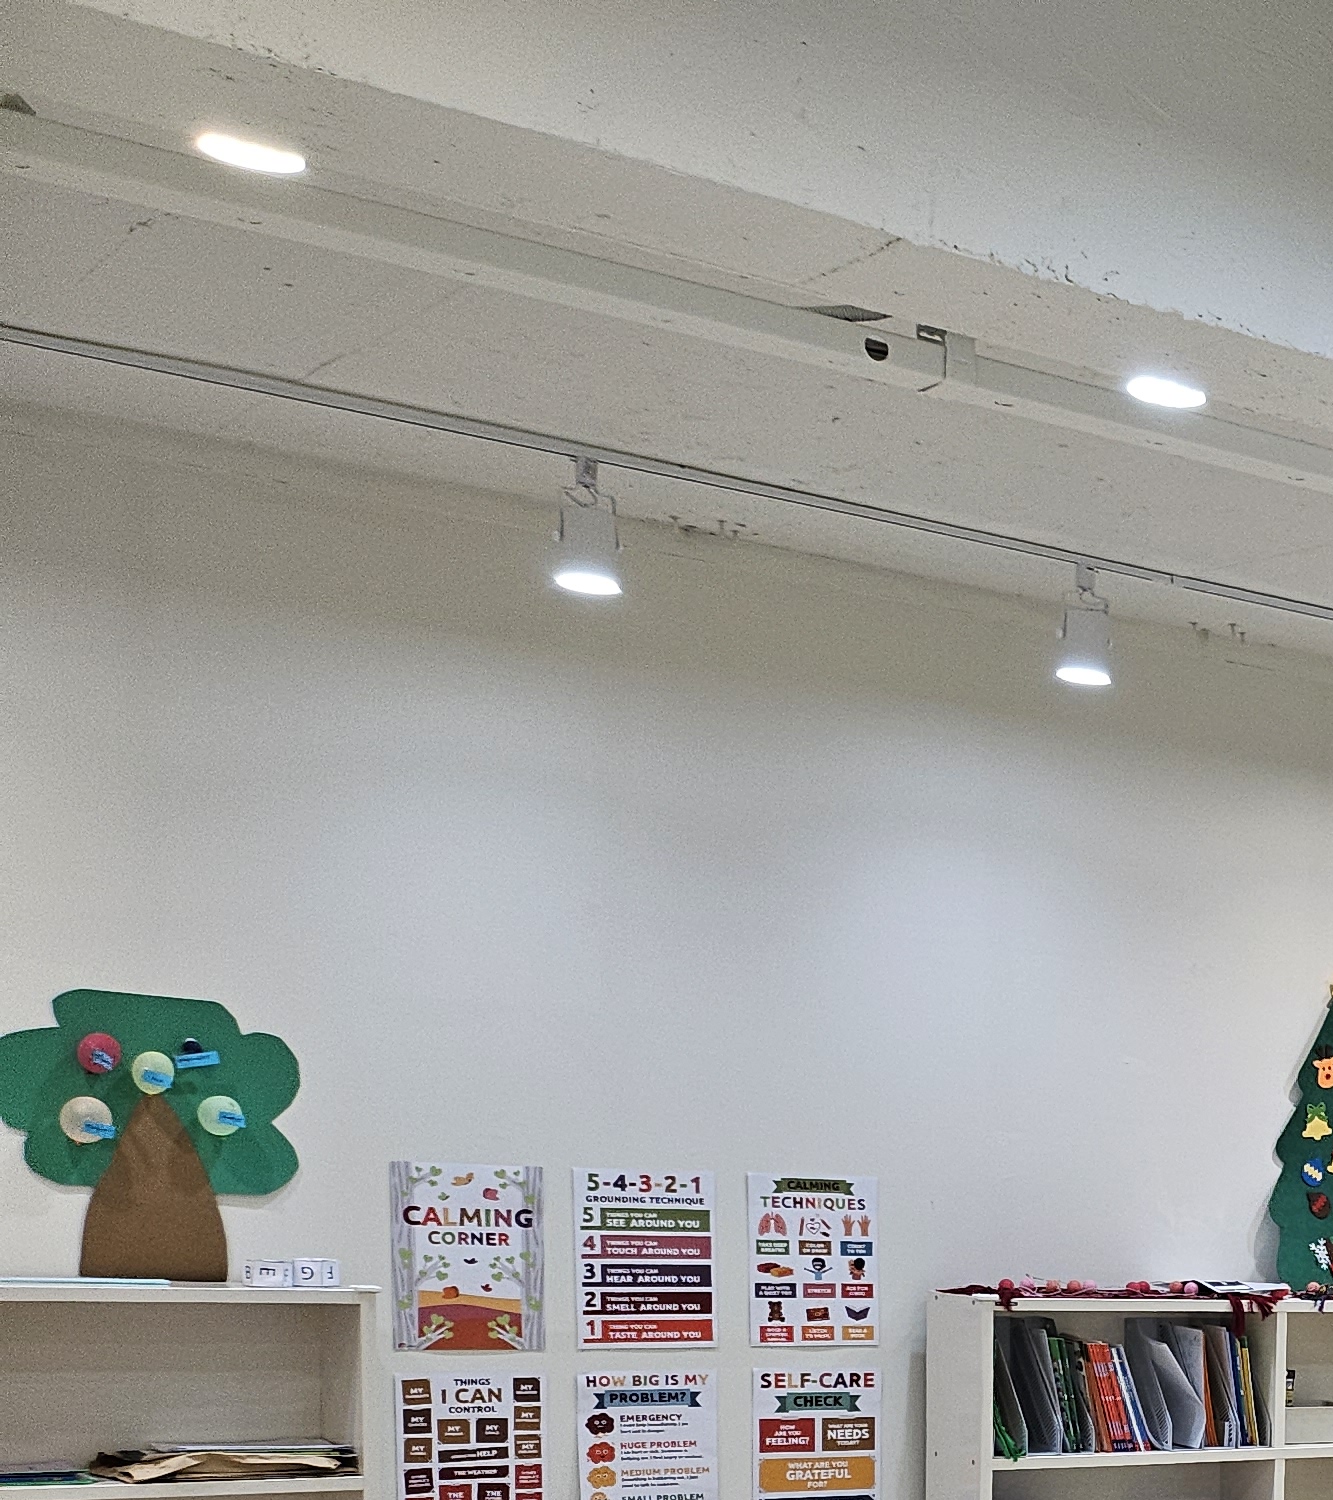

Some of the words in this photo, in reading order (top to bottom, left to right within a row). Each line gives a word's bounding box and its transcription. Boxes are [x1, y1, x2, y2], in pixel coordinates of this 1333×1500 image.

[587, 1173, 701, 1194] 5-4-3-2-1
[787, 1180, 840, 1191] CALMING
[585, 1195, 647, 1204] GROUNDING
[649, 1196, 705, 1206] TECHNIQUE
[760, 1196, 866, 1212] TECHNIQUES
[402, 1205, 533, 1229] CALMING
[583, 1206, 594, 1223] 5
[606, 1219, 627, 1228] SEE
[629, 1219, 676, 1228] AROUND
[678, 1220, 700, 1228] YOU
[427, 1230, 510, 1247] CORNER
[583, 1235, 596, 1251] 4
[606, 1247, 638, 1255] TOUCH
[641, 1247, 679, 1255] AROUND
[681, 1248, 700, 1256] YOU
[259, 1267, 276, 1277] E
[301, 1266, 315, 1281] G
[583, 1263, 596, 1280] 3
[606, 1275, 634, 1283] HEAR
[637, 1275, 679, 1283] AROUND
[680, 1275, 701, 1283] YOU
[584, 1291, 597, 1308] 2
[605, 1303, 637, 1311] SMELL
[640, 1303, 679, 1311] AROUND
[681, 1303, 701, 1311] YOU
[586, 1320, 596, 1336] 1
[608, 1331, 638, 1339] TASTE
[641, 1331, 680, 1339] AROUND
[682, 1331, 702, 1339] YOU
[453, 1378, 491, 1386] THINGS
[585, 1375, 626, 1388] HOW
[632, 1375, 660, 1387] BIG
[665, 1374, 679, 1386] IS
[684, 1374, 709, 1386] MY
[760, 1372, 875, 1389] SELF-CARE
[441, 1389, 447, 1404] I
[455, 1388, 503, 1404] CAN
[609, 1392, 687, 1404] PROBLEM?
[793, 1396, 844, 1407] CHECK
[448, 1406, 498, 1414] CONTROL
[620, 1414, 683, 1423] EMERGENCY
[827, 1428, 870, 1440] NEEDS
[620, 1441, 648, 1450] HUGE
[650, 1440, 698, 1449] PROBLEM
[765, 1437, 810, 1446] FEELING?
[788, 1461, 813, 1469] WHAT
[813, 1461, 830, 1469] ARE
[831, 1460, 849, 1468] YOU
[621, 1468, 660, 1477] MEDIUM
[664, 1467, 710, 1475] PROBLEM
[786, 1469, 852, 1481] GRATEFUL
